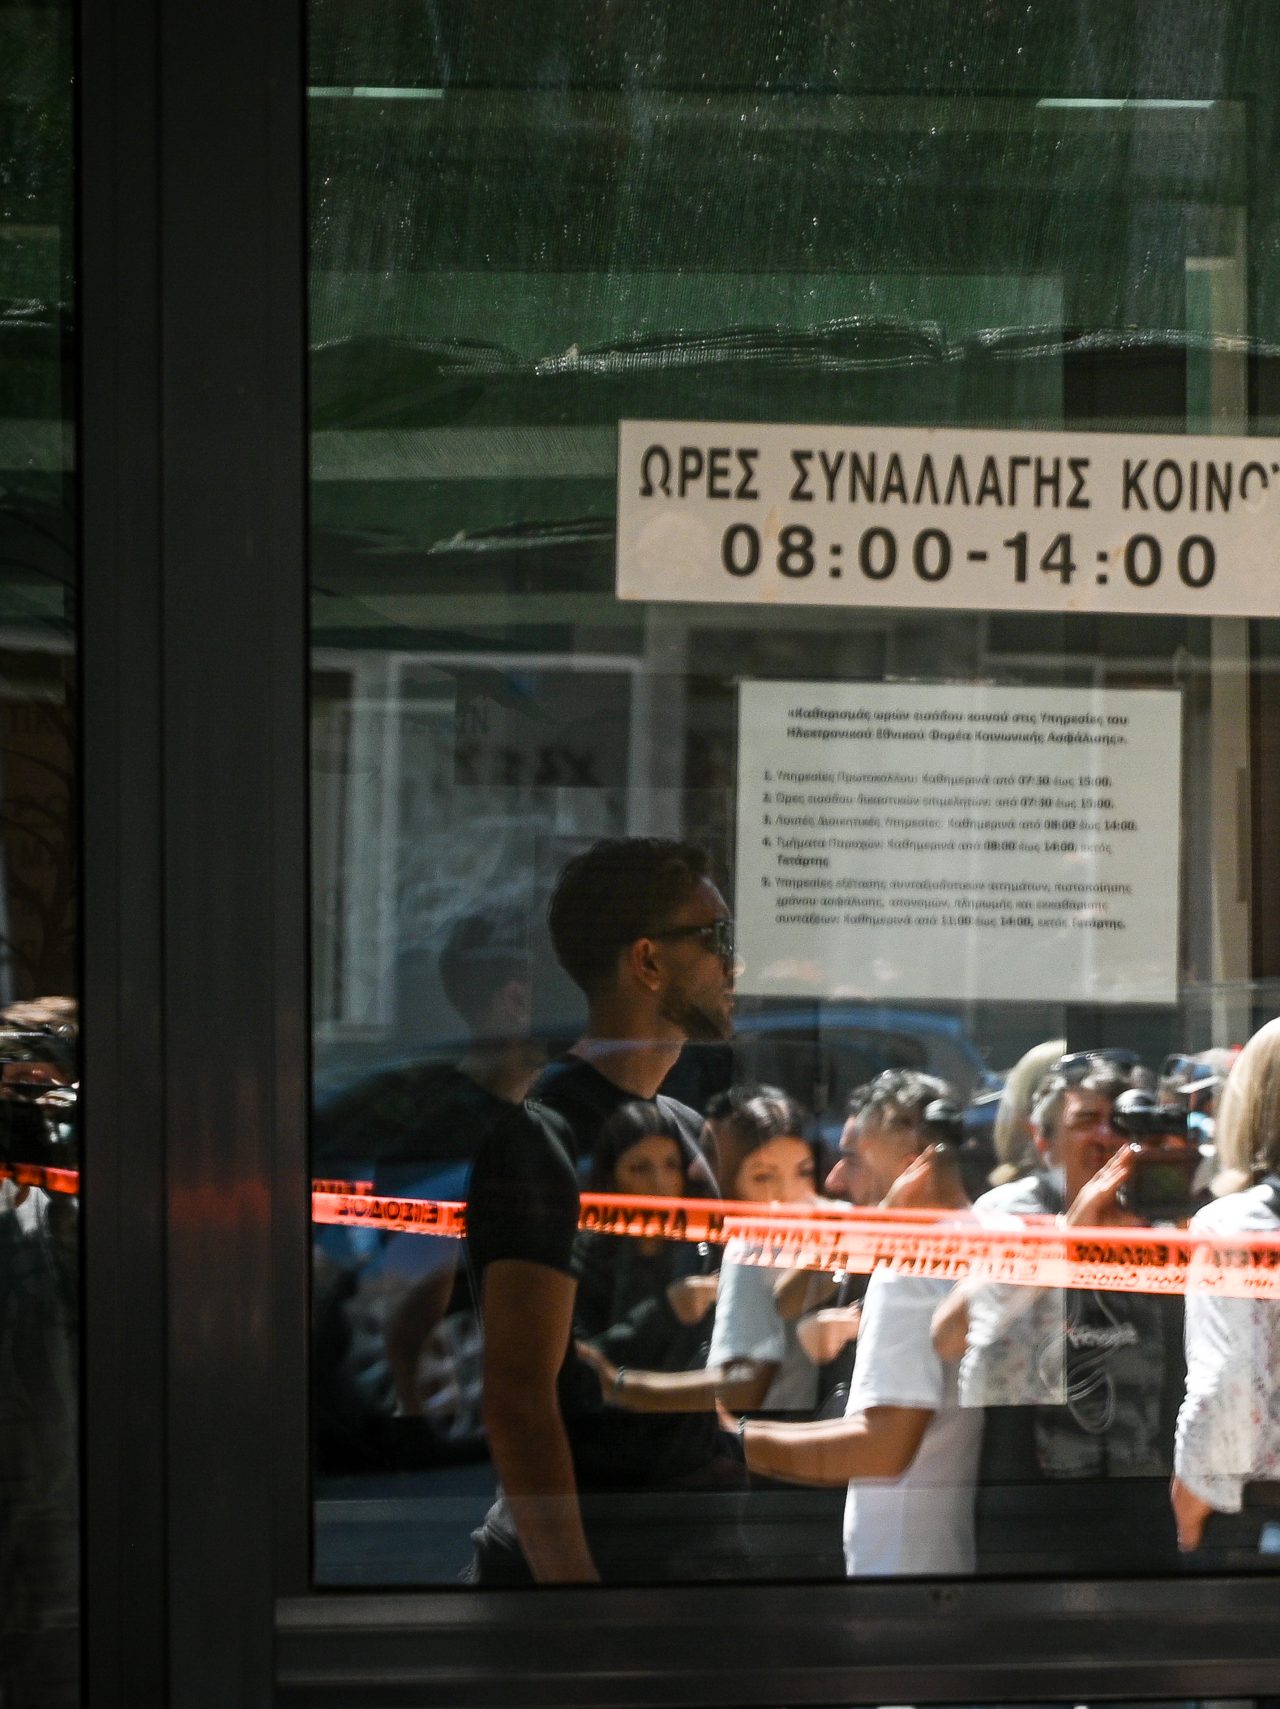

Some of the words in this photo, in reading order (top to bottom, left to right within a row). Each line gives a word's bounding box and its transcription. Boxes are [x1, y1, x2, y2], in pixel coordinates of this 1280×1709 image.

[639, 445, 760, 500] ΩΡΕΣ
[789, 449, 1091, 509] ΣΥΝΑΛΛΑΓΗΣ
[721, 523, 1217, 588] 08:00-14:00
[1012, 713, 1036, 725] στις
[1040, 712, 1103, 726] Υπηρεσίες
[1107, 716, 1128, 725] του
[787, 727, 872, 741] Ηλεκτρονικού
[876, 728, 924, 740] Εθνικού
[929, 729, 971, 742] Φορέα
[975, 731, 1043, 744] Κοινωνικής
[776, 770, 834, 783] Υπηρεσίες
